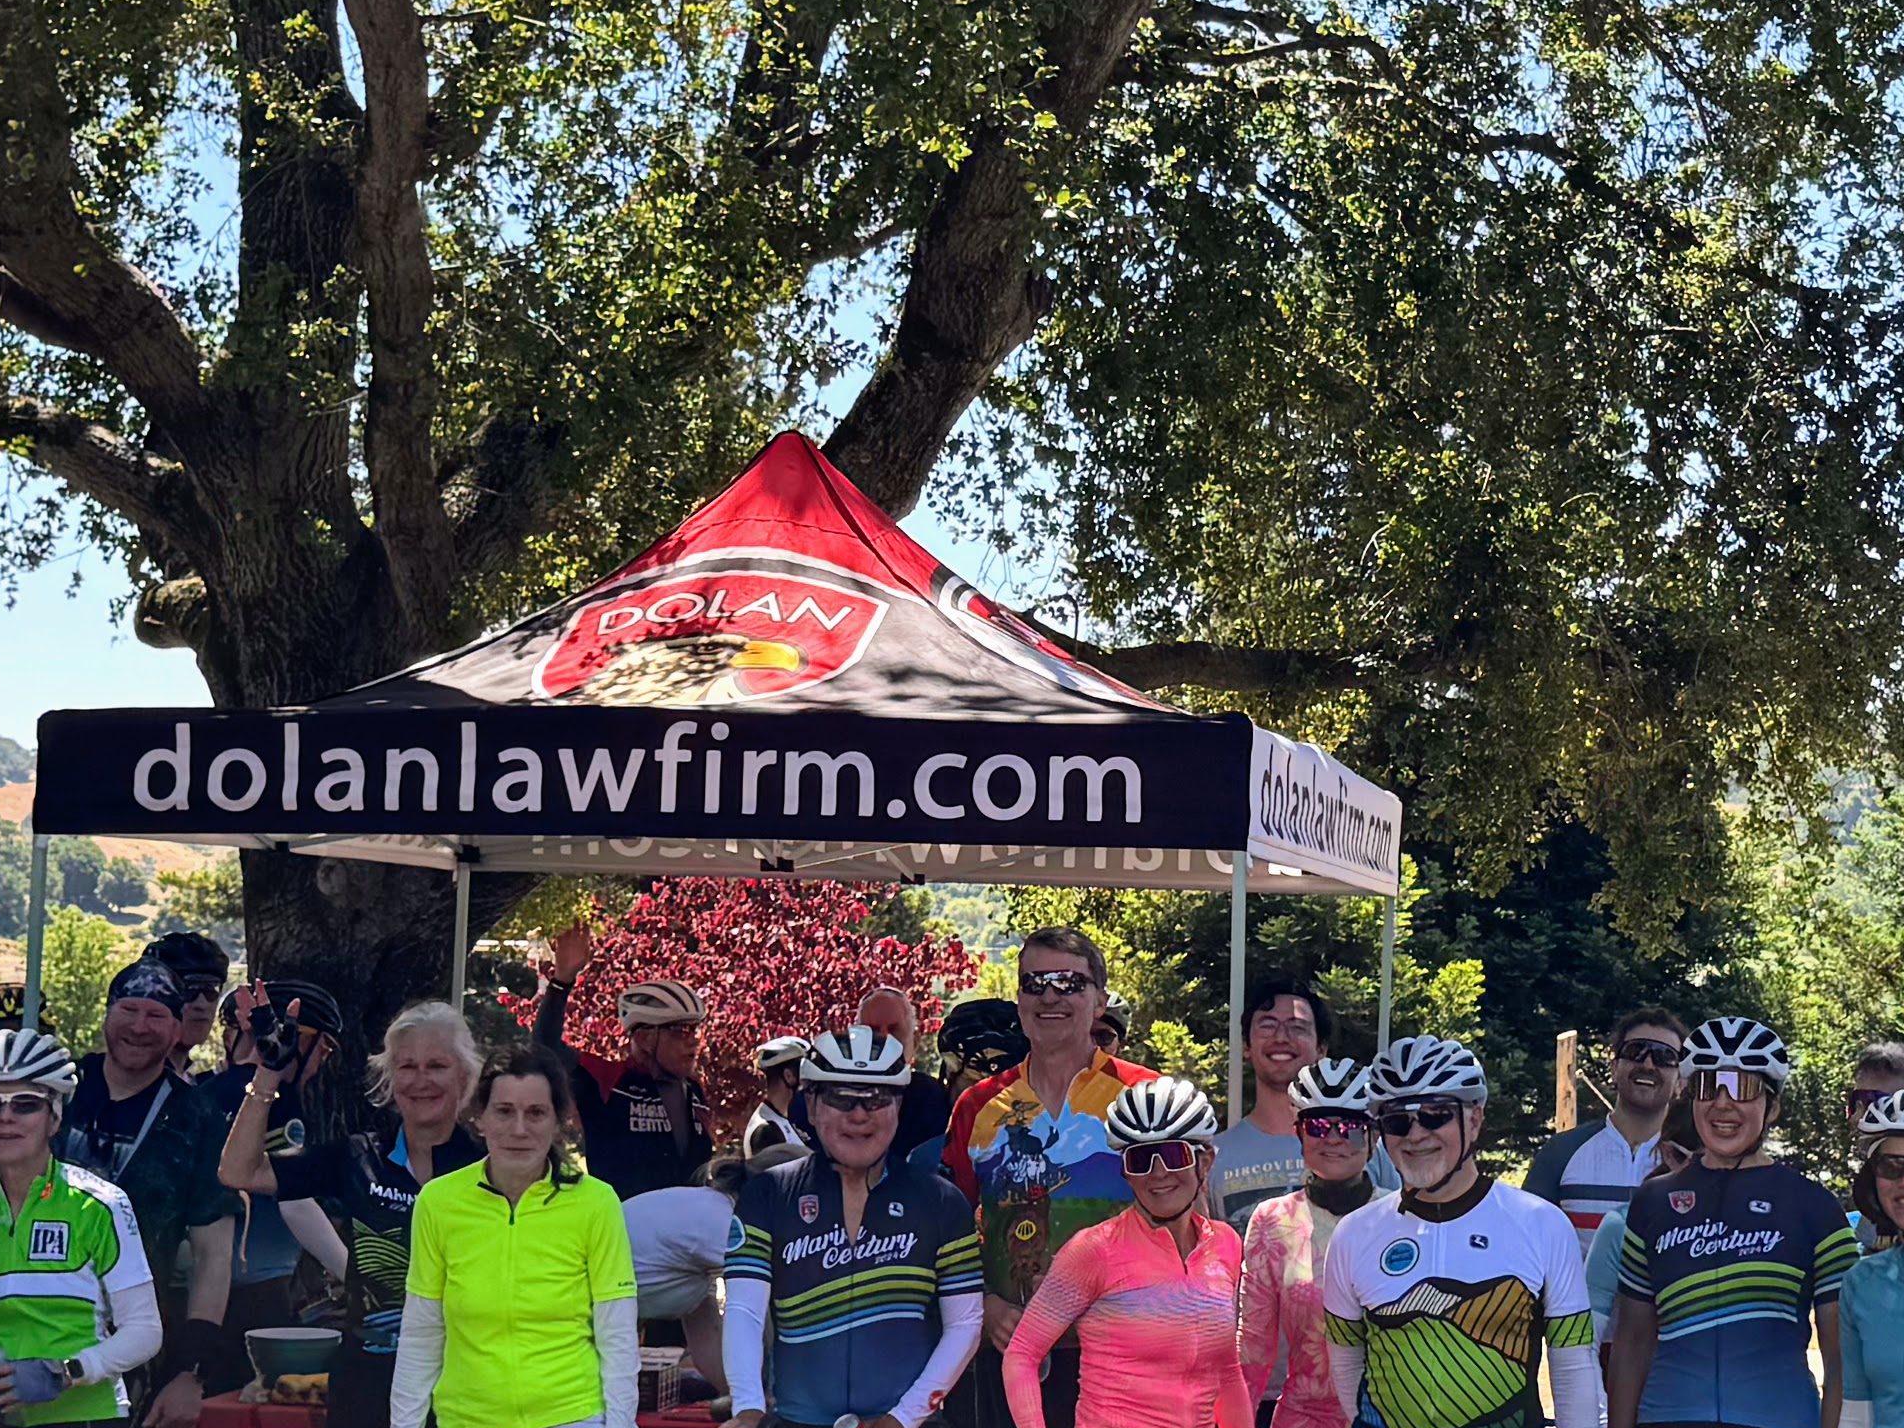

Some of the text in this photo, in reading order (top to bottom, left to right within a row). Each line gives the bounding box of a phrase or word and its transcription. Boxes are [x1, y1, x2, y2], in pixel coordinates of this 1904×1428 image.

[597, 589, 854, 636] DOLAN
[132, 720, 1142, 823] dolanlawfirm.com
[1261, 744, 1393, 873] dolanlawfirm.com
[33, 1228, 66, 1255] IPA
[822, 1232, 918, 1269] Century
[1654, 1218, 1728, 1254] Marin
[1689, 1229, 1785, 1258] Century
